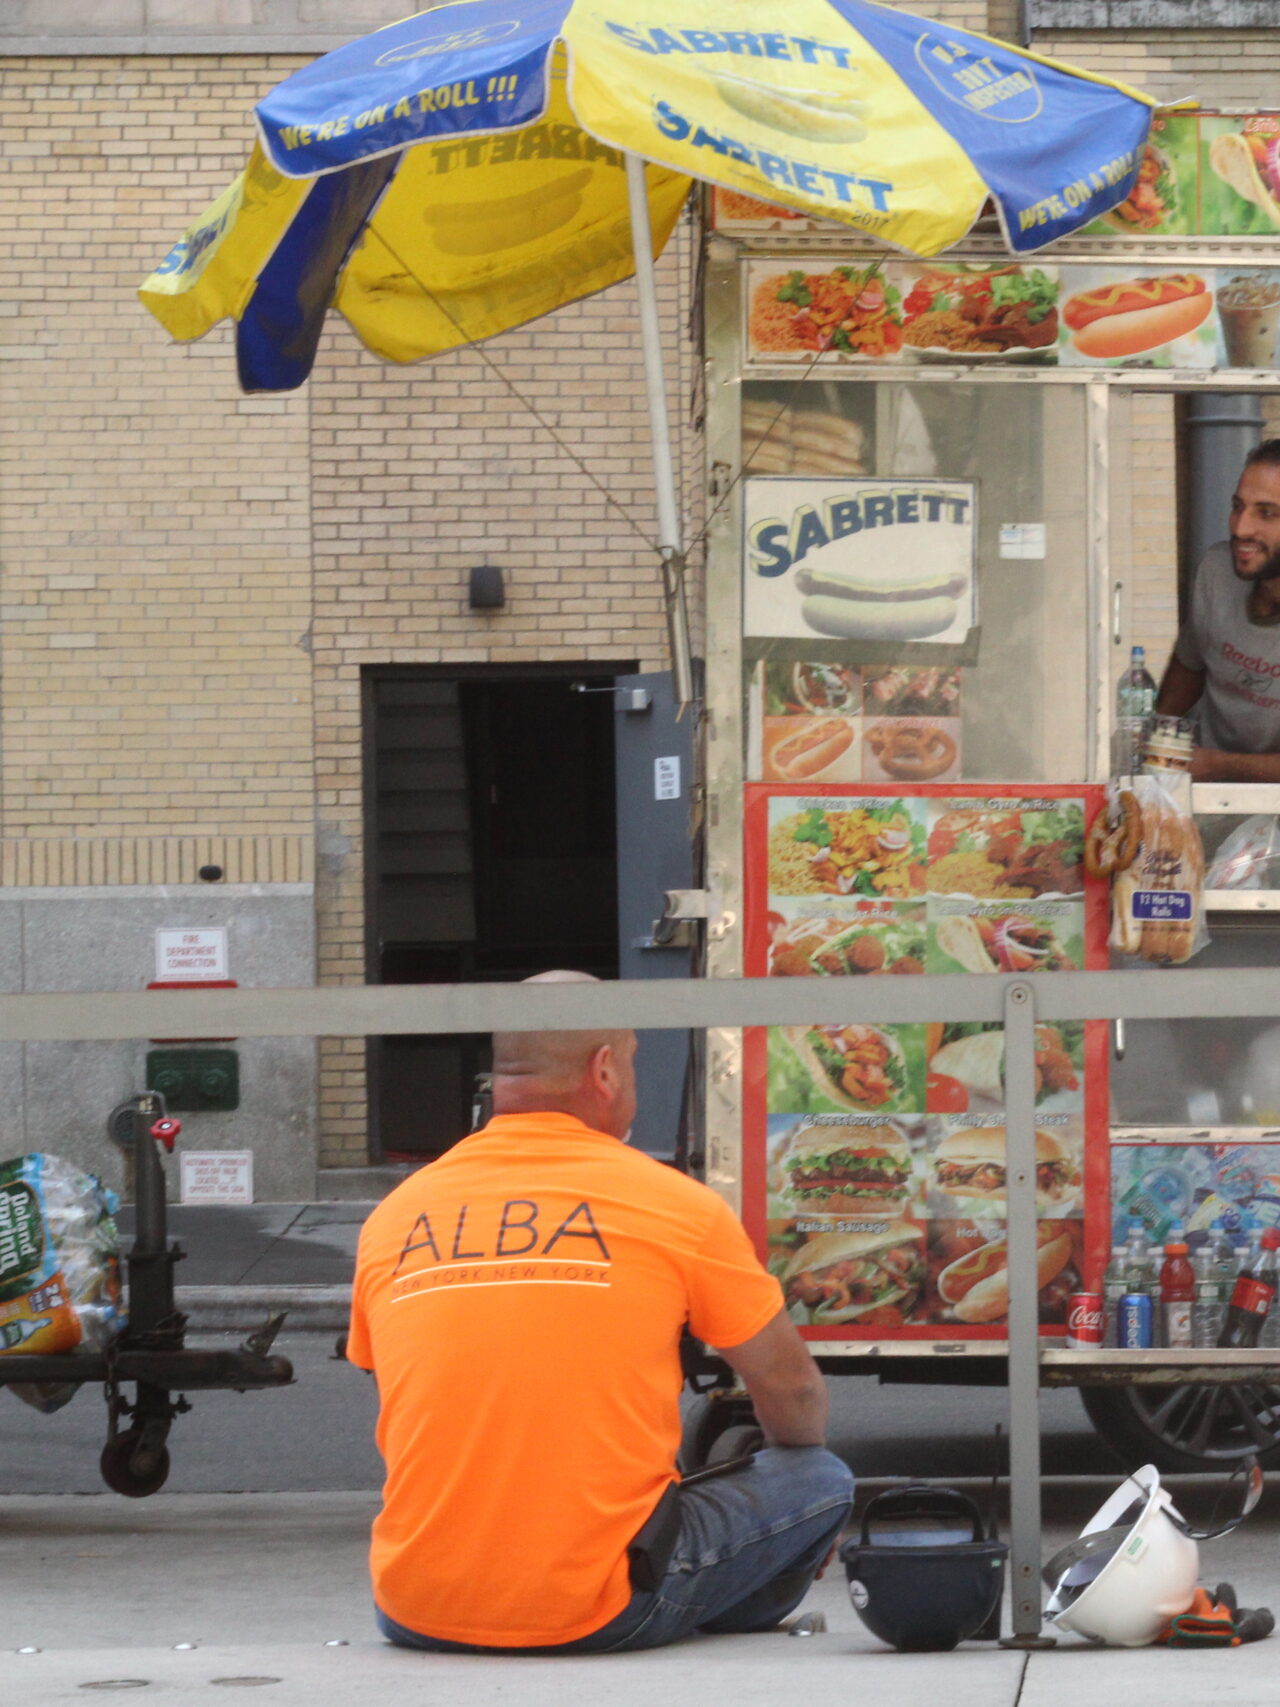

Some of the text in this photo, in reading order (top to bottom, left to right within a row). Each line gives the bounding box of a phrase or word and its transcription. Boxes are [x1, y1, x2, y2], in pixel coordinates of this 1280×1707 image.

[603, 20, 852, 70] SABRETT
[279, 116, 349, 150] WE'RE
[354, 103, 389, 129] ON
[394, 96, 410, 118] A
[417, 81, 479, 112] ROLL
[655, 99, 893, 213] SABRETT
[1064, 179, 1092, 208] ON
[851, 210, 889, 231] 2017
[748, 487, 970, 578] SABRETT
[1152, 894, 1168, 905] Hot
[11, 1190, 37, 1258] Poland
[392, 1200, 611, 1276] ALBA
[796, 1221, 889, 1235] Italian Sausage
[551, 1266, 609, 1282] YORK
